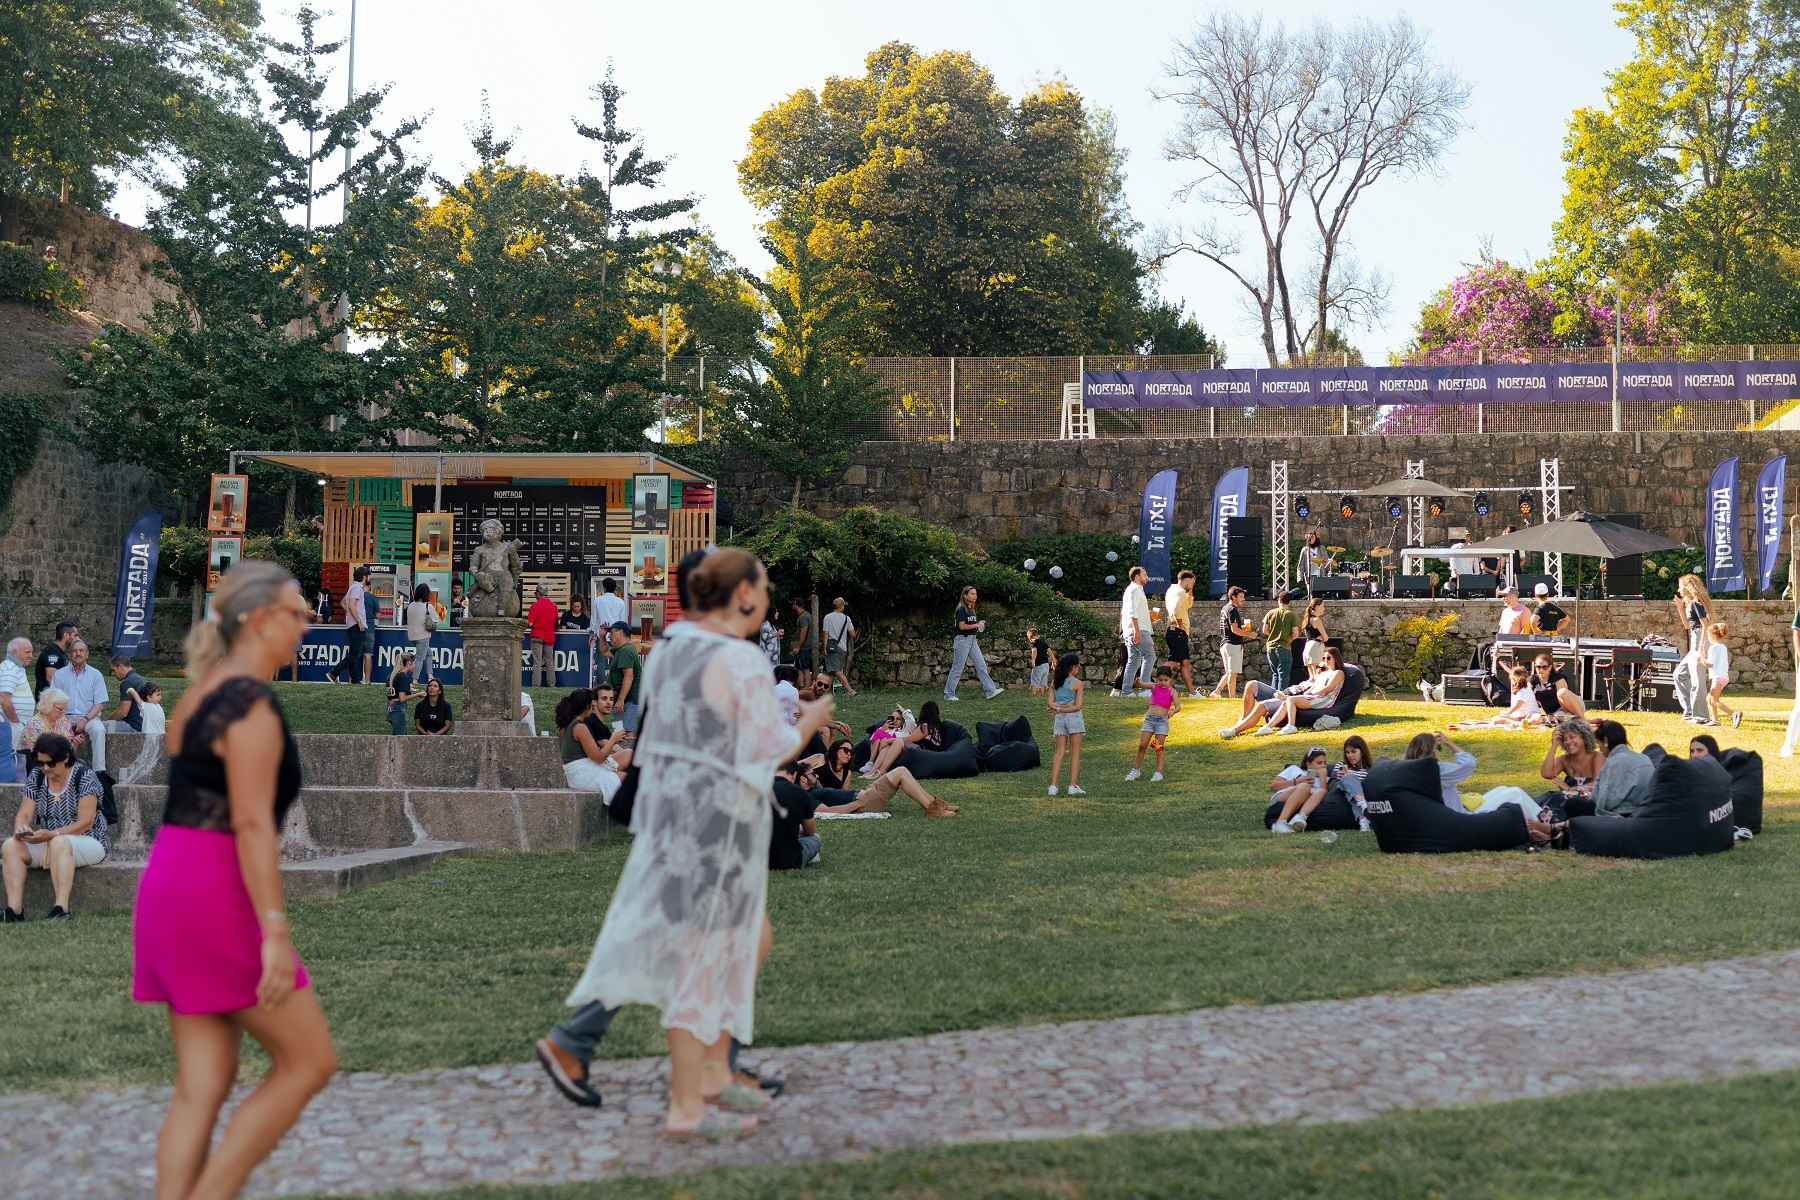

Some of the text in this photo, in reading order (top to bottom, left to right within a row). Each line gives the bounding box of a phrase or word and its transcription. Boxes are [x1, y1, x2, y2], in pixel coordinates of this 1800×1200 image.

[1380, 380, 1428, 391] NORTADA
[1438, 378, 1487, 390] NORTADA
[1497, 377, 1546, 389] NORTADA
[1559, 376, 1608, 388] NORTADA
[1623, 375, 1672, 387] NORTADA
[1685, 375, 1734, 386] NORTADA
[1747, 374, 1796, 385] NORTADA
[1088, 384, 1134, 395] NORTADA
[1145, 384, 1192, 395] NORTADA
[1203, 382, 1250, 393] NORTADA
[1263, 382, 1310, 393] NORTADA
[1321, 380, 1368, 392] NORTADA
[1149, 494, 1168, 531] FIXE!
[1714, 487, 1733, 569] NORTADA
[124, 543, 150, 635] NORTADA
[299, 644, 350, 666] RTADA
[378, 645, 464, 669] NOADA
[1367, 800, 1393, 813] ORTADA
[1709, 798, 1733, 824] NORT
